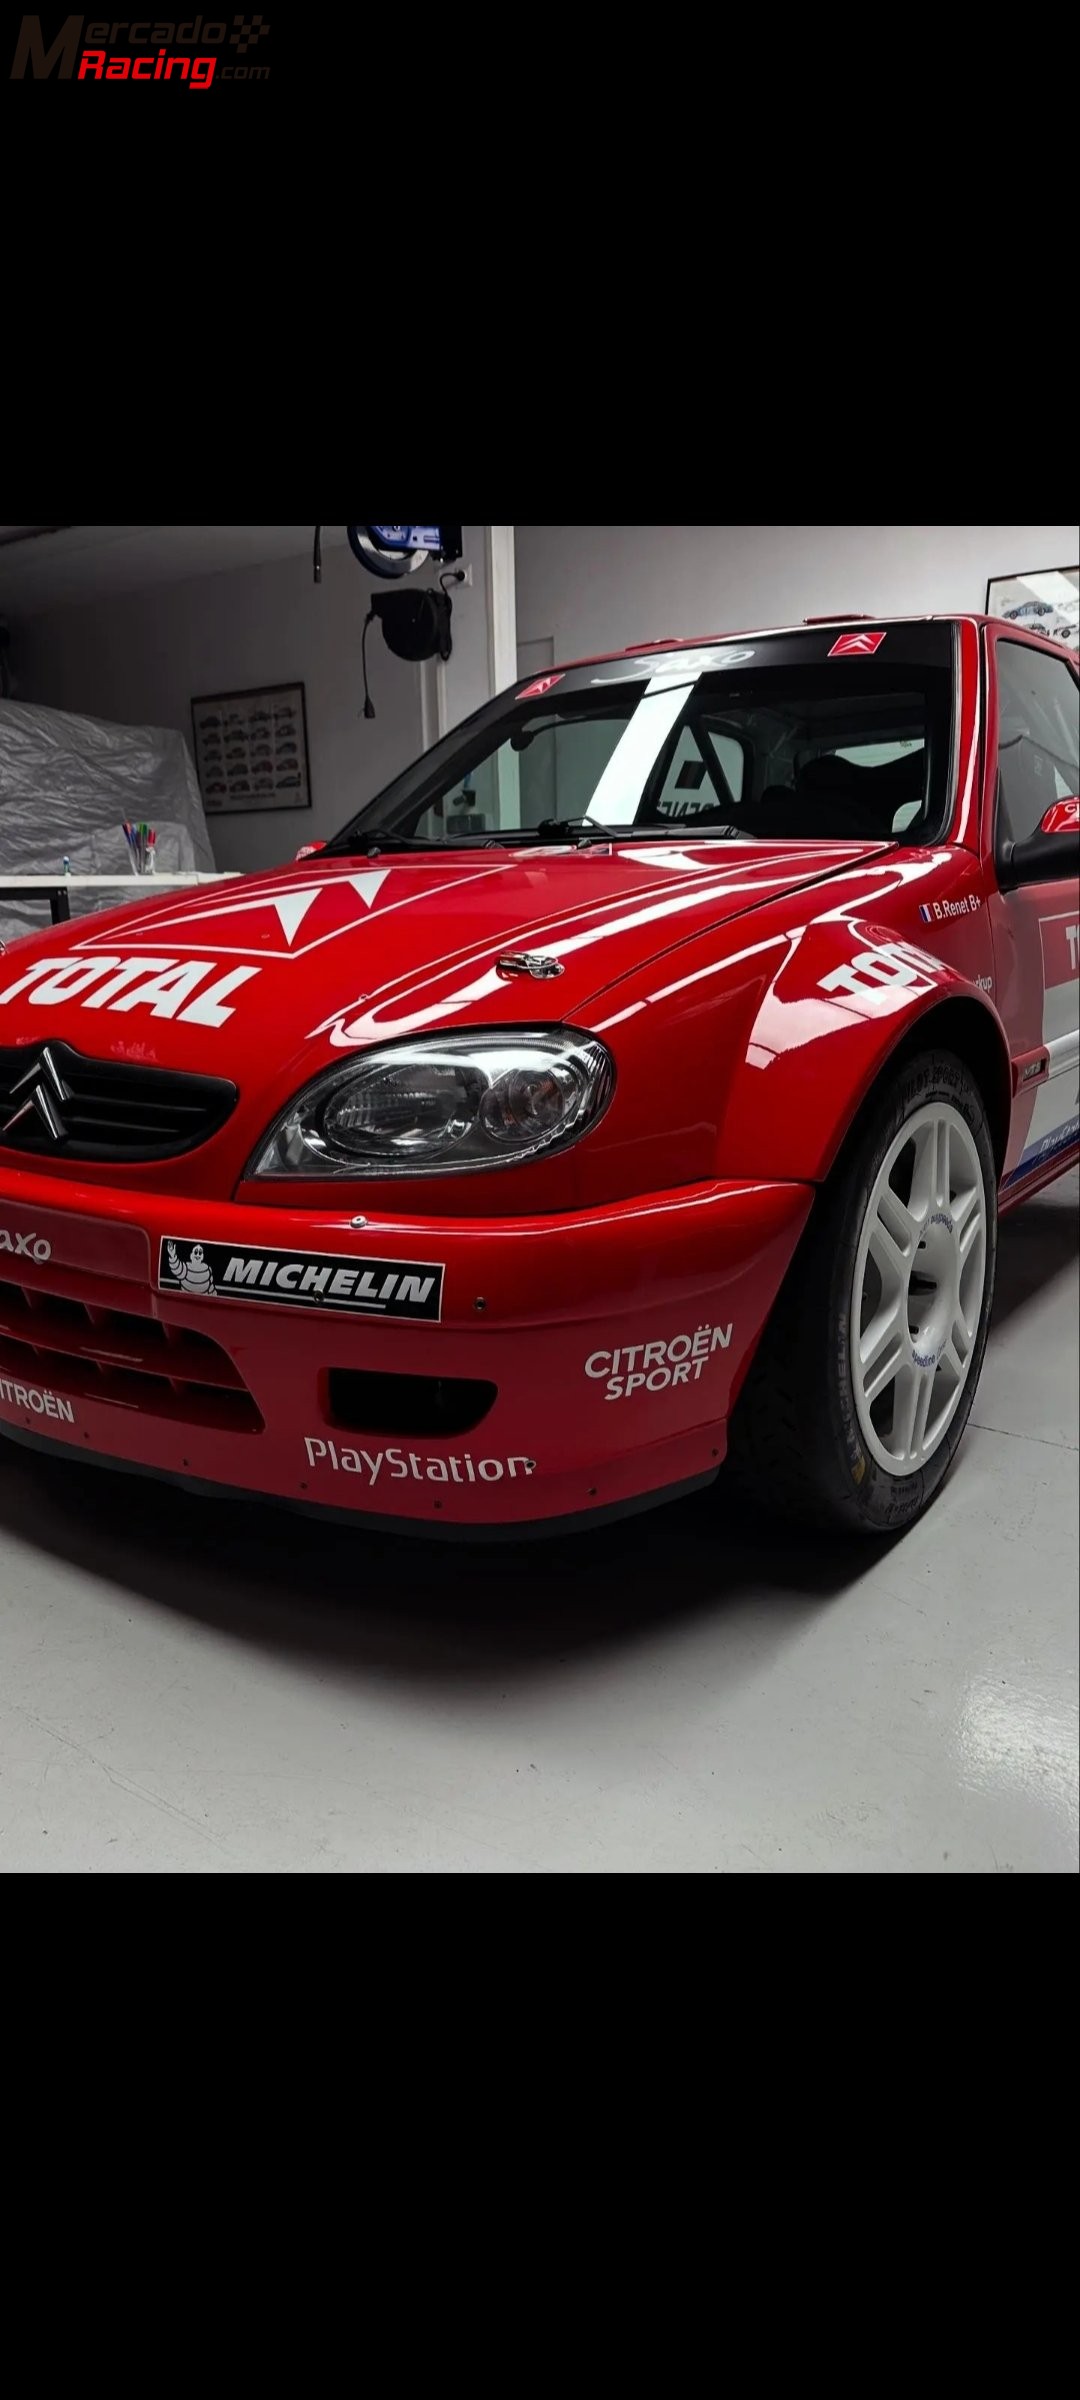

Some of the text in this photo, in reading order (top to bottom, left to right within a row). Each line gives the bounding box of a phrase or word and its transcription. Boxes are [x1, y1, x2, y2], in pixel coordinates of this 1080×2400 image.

[932, 896, 970, 920] B.Renet
[0, 956, 263, 1029] TOTAL
[222, 1257, 436, 1304] MICHELIN
[584, 1323, 733, 1379] CITROËN
[604, 1356, 709, 1401] SPORT
[304, 1437, 535, 1486] PlayStation
